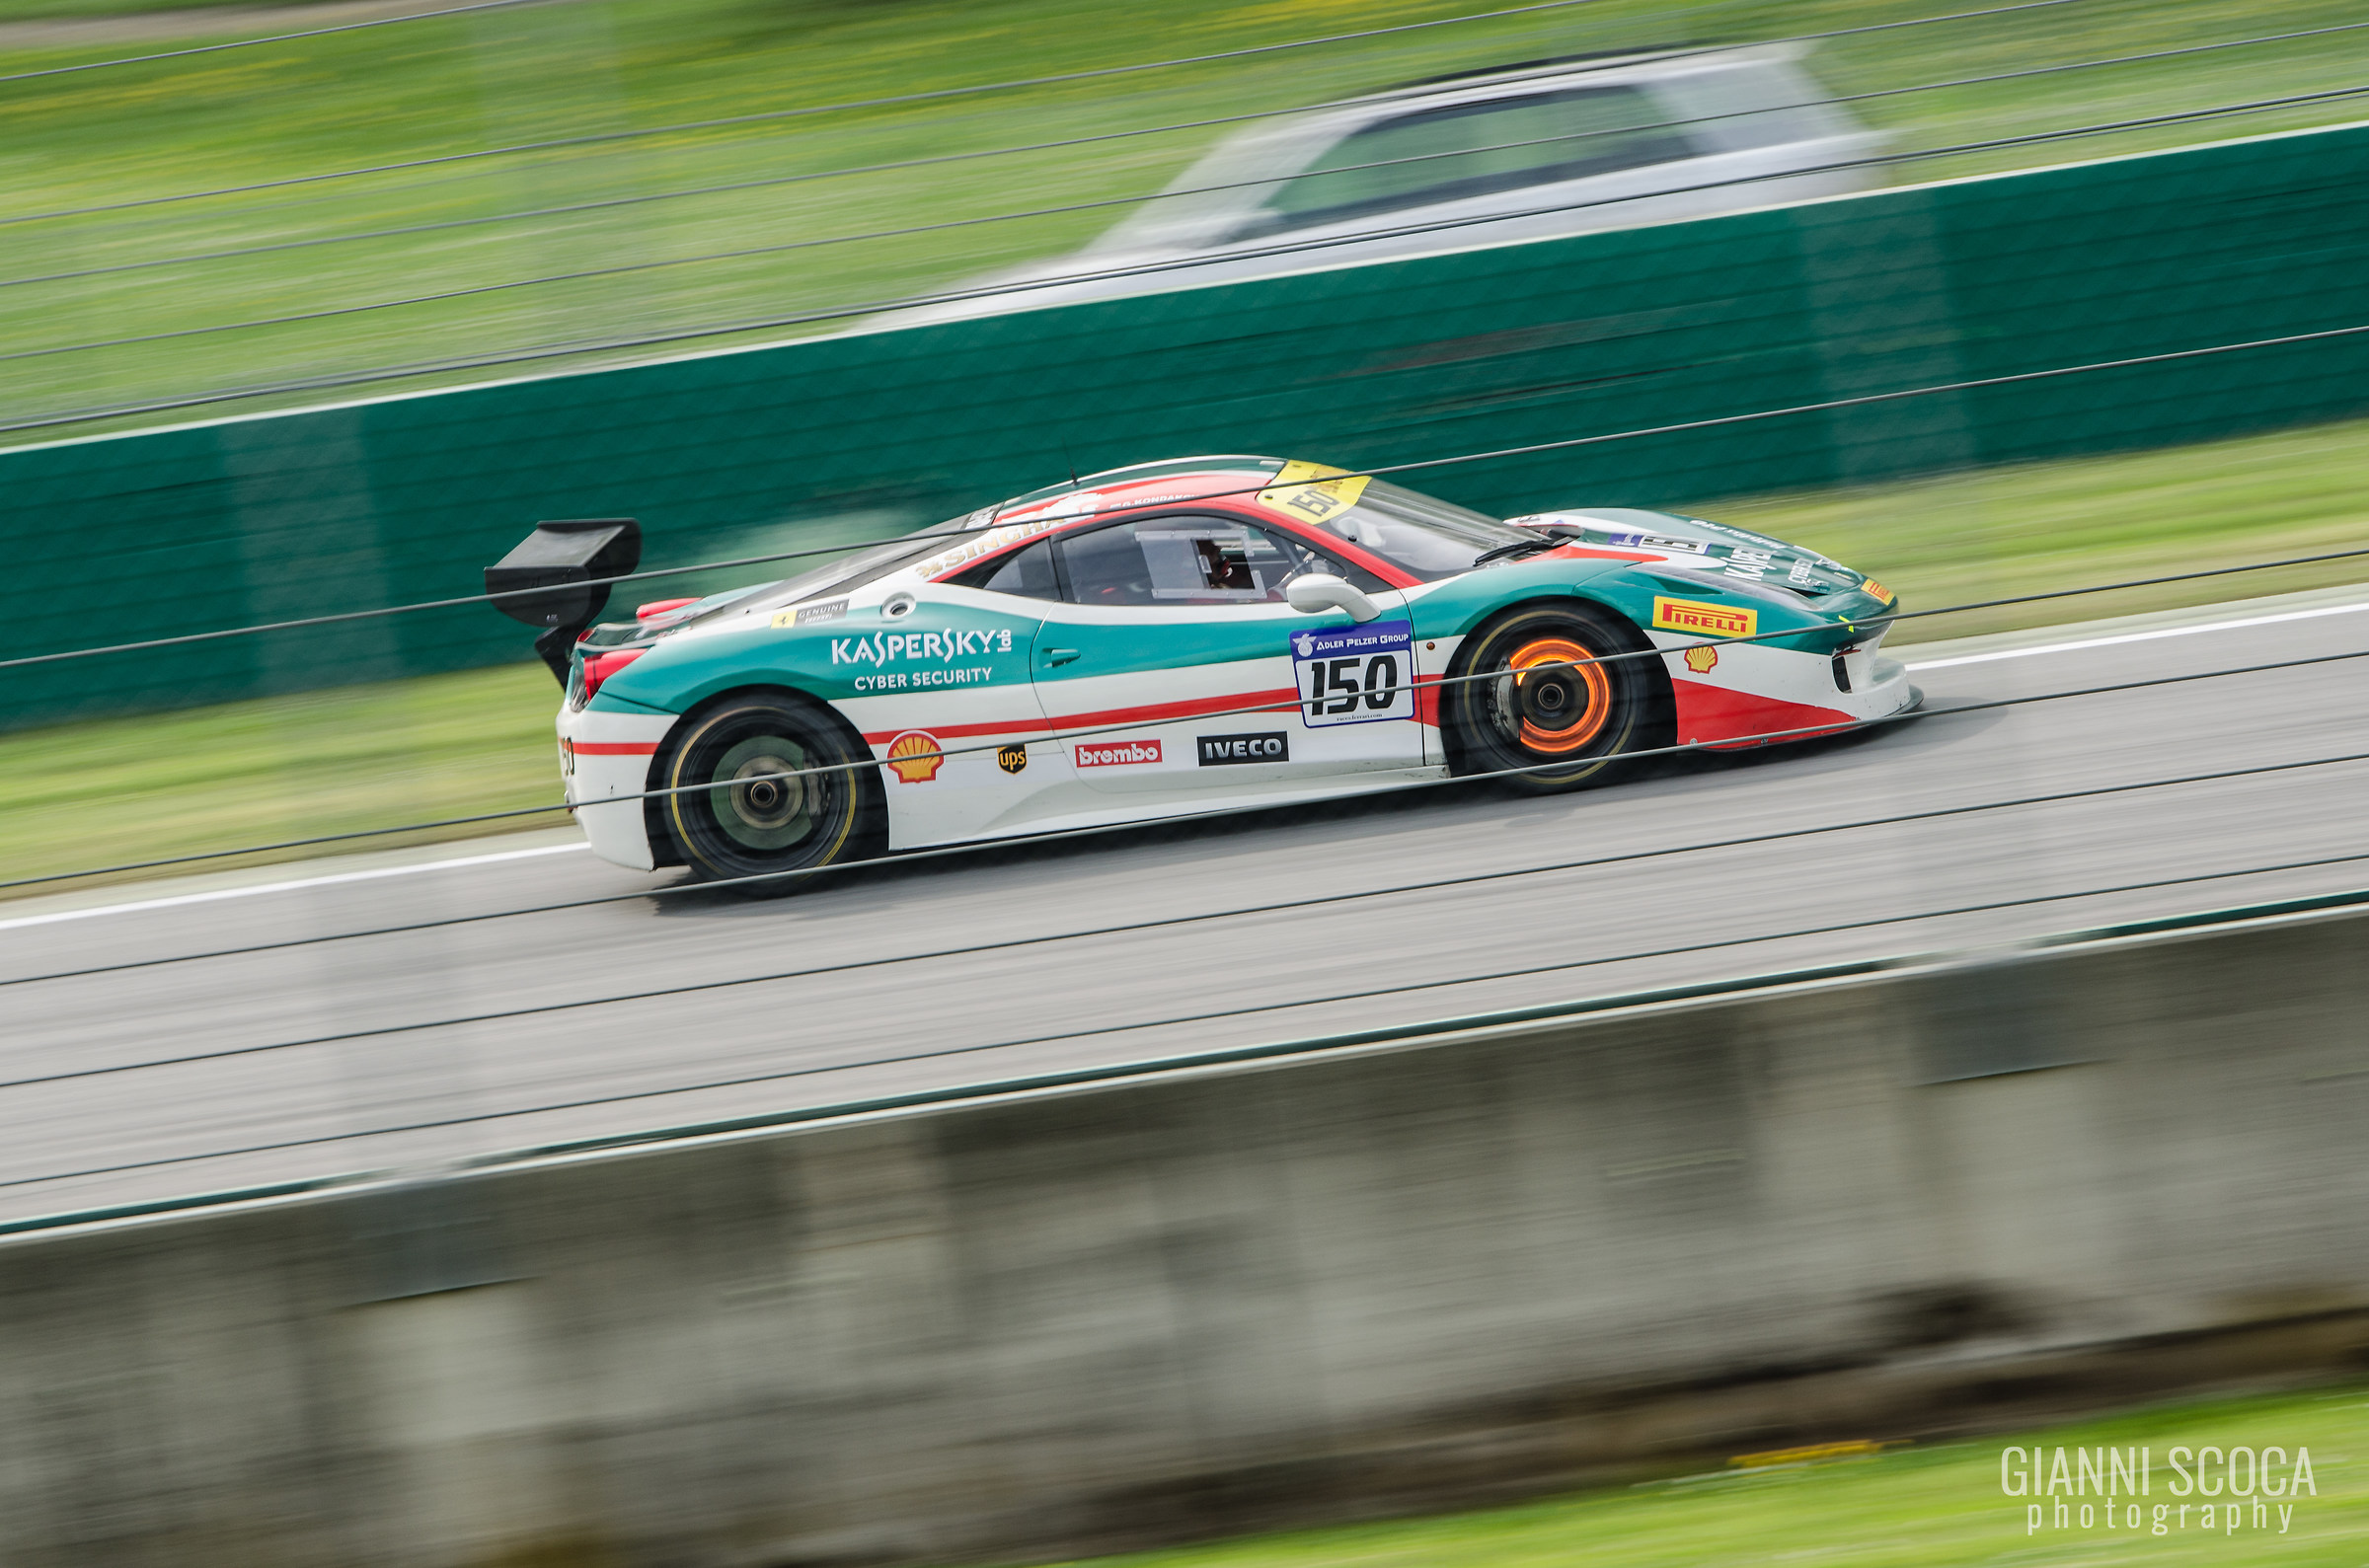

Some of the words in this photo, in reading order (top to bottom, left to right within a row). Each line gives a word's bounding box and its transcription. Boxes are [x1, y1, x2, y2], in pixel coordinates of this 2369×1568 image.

[1287, 489, 1339, 517] 150
[798, 603, 845, 619] GENUINE
[1662, 603, 1748, 633] PIRELLI
[831, 628, 996, 668] KASPERSKY
[997, 629, 1012, 652] lab
[1316, 640, 1344, 651] ADLER
[1346, 636, 1378, 648] PELZER
[1380, 634, 1409, 644] GROUP
[854, 672, 908, 691] CYBER
[912, 667, 993, 687] SECURITY
[1311, 654, 1398, 716] 150
[1079, 742, 1159, 765] brembo
[1204, 738, 1282, 759] IVECO
[999, 750, 1026, 771] ups
